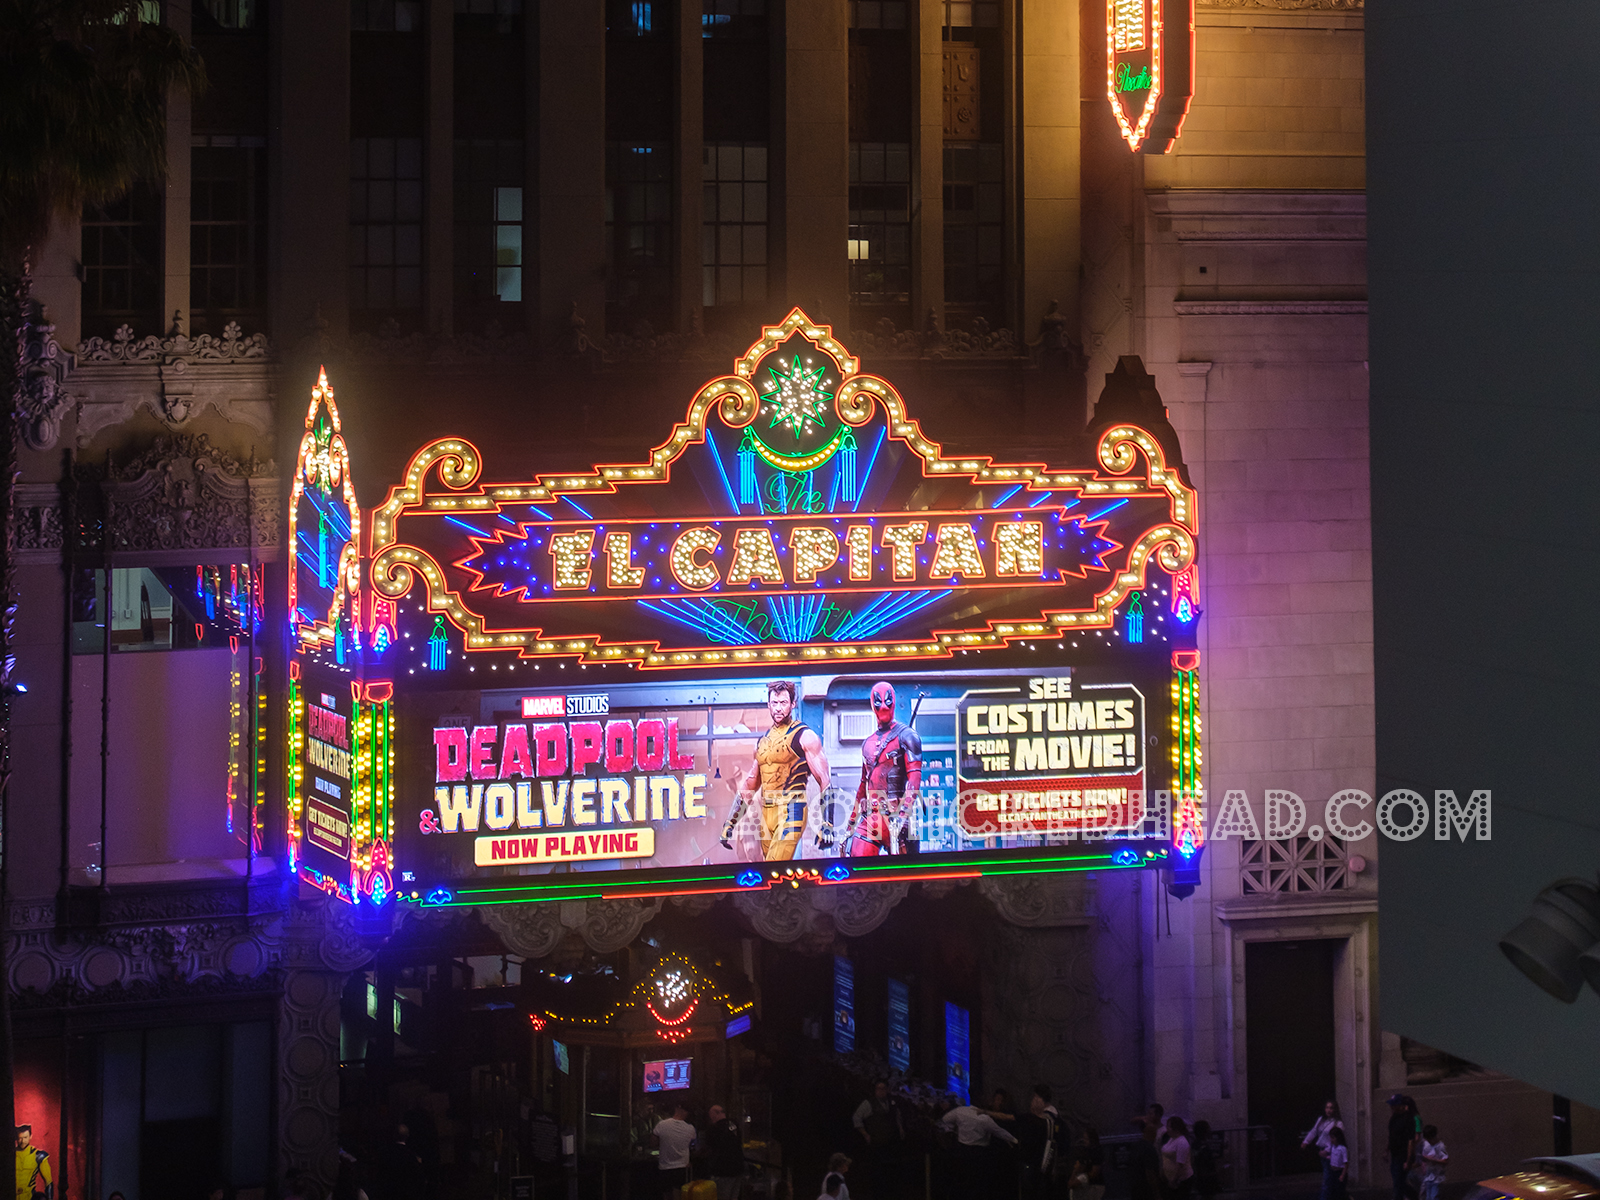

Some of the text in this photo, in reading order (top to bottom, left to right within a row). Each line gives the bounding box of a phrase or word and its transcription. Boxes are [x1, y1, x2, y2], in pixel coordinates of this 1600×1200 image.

[764, 472, 825, 513] The
[548, 521, 1045, 592] EL CAPITAN
[523, 696, 609, 716] MARVEL STUDIOS
[1029, 677, 1072, 700] SEE
[967, 700, 1135, 735] COSTUMES
[308, 737, 351, 780] WOLVERINE
[433, 717, 695, 783] DEADPOOL
[967, 739, 1010, 755] FROM
[981, 757, 1010, 771] THE
[1014, 734, 1136, 771] MOVIE!
[418, 774, 708, 835] & WOLVERINE
[976, 788, 1128, 811] GET TICKETS NOW!
[491, 832, 638, 860] NOW PLAYING
